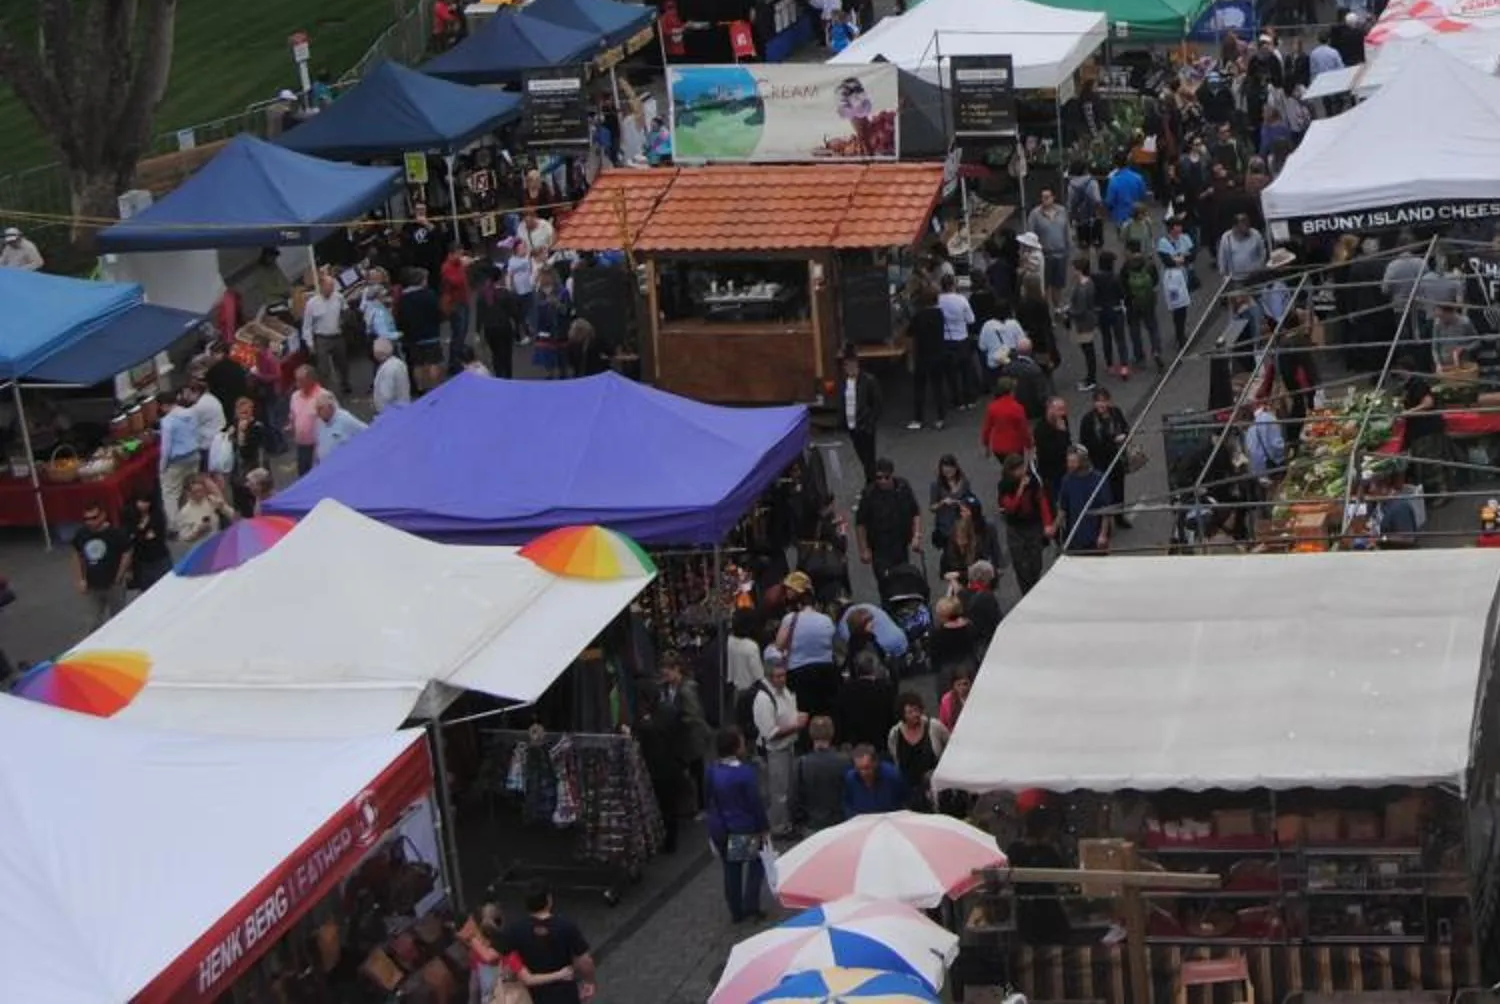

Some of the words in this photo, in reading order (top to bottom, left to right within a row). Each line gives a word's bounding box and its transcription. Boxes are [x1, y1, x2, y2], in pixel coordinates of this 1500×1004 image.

[1302, 214, 1364, 235] BRUNY
[1368, 205, 1435, 227] ISLAND
[197, 927, 245, 993] HENK
[244, 886, 289, 946] BERG
